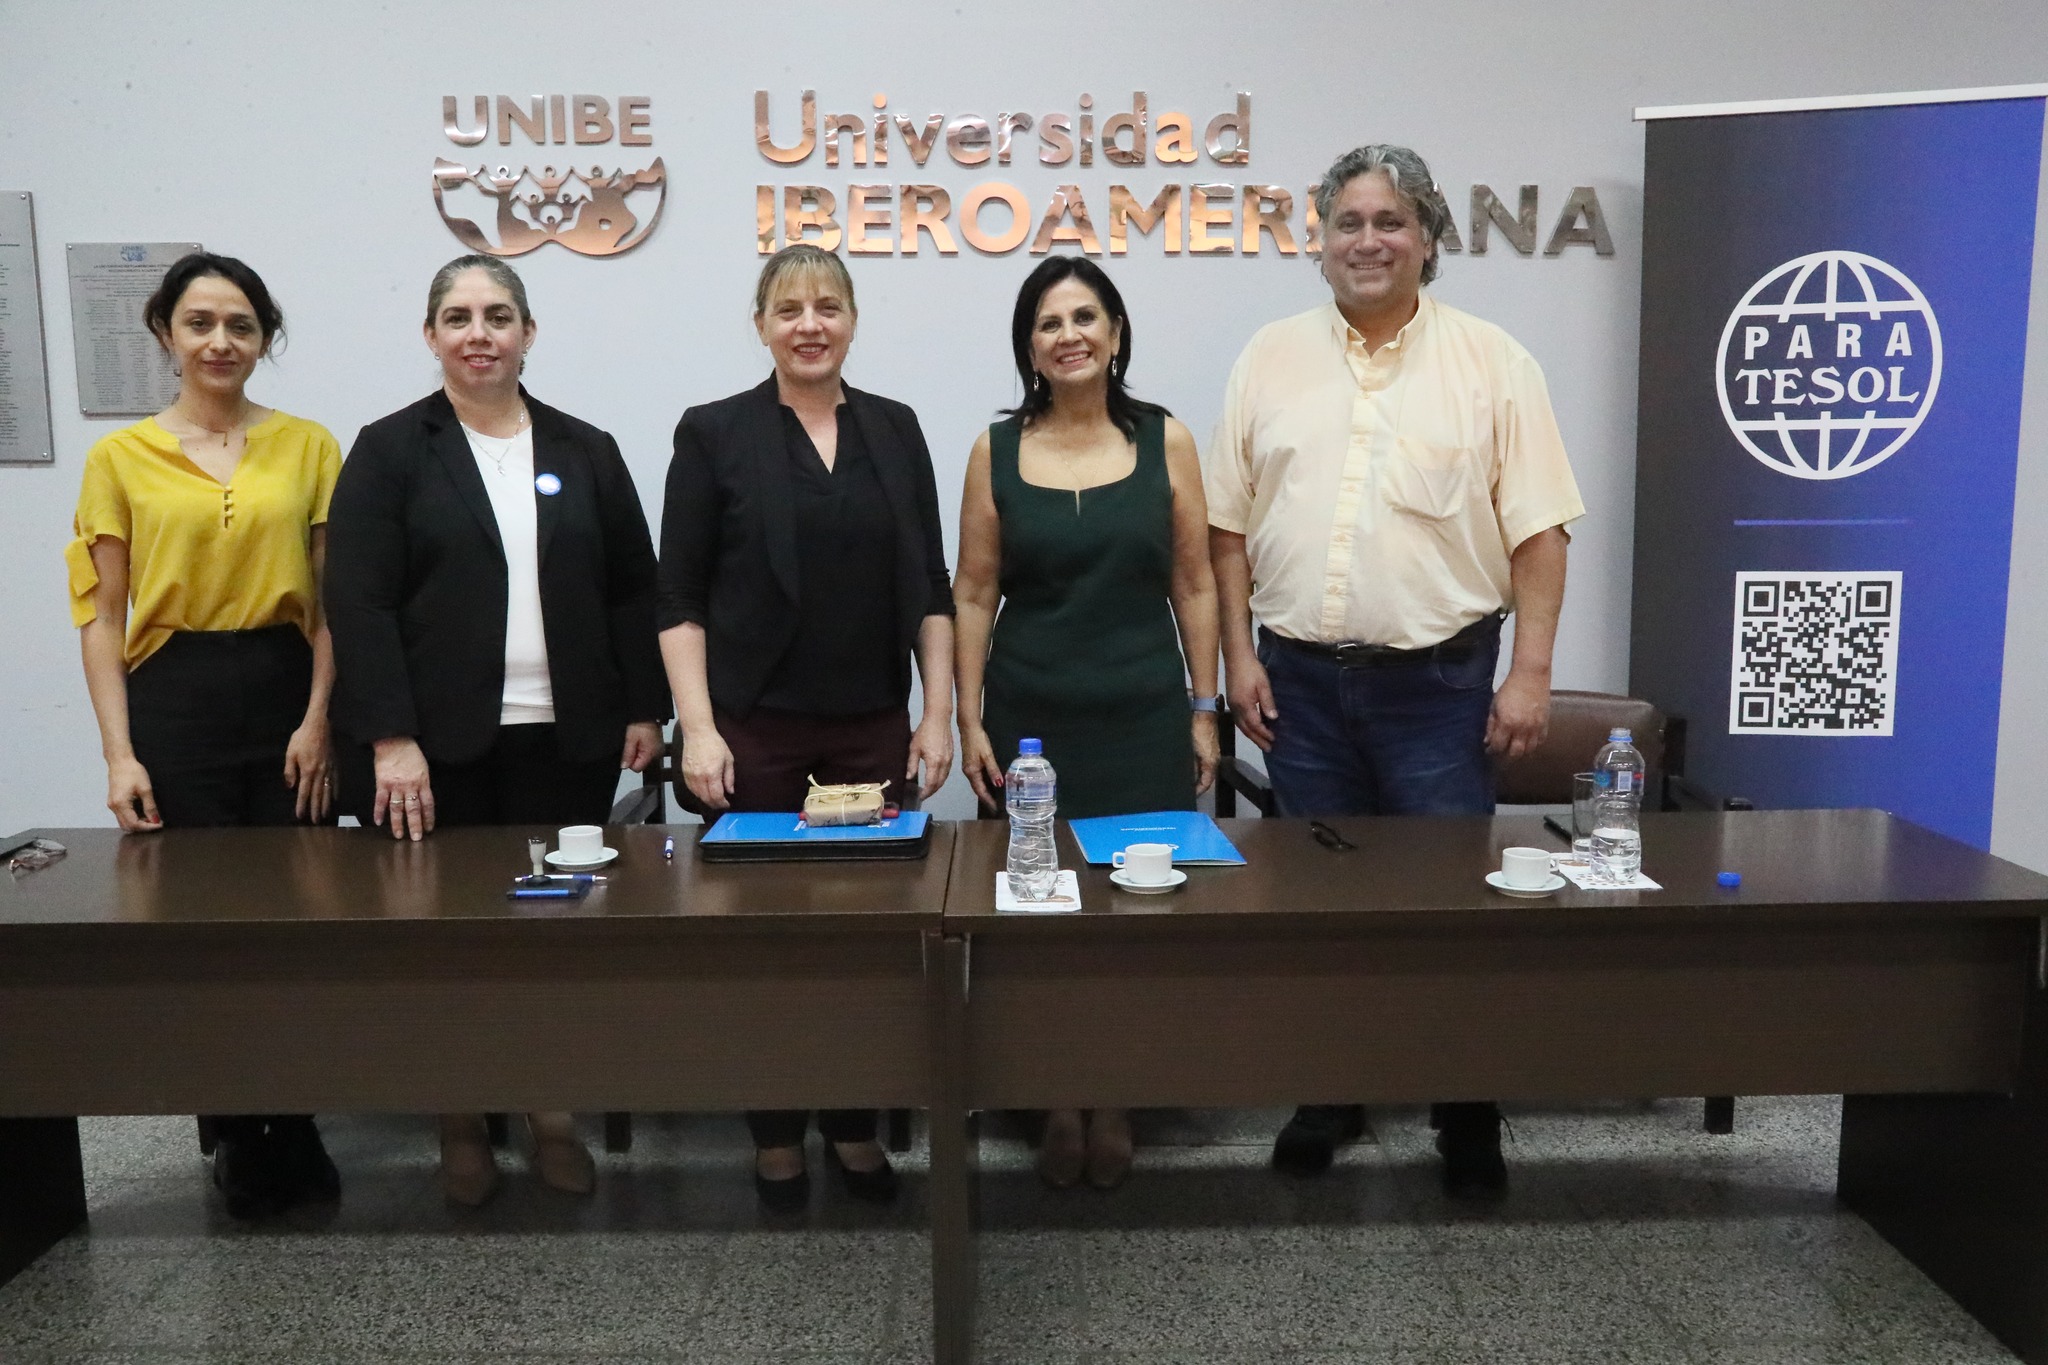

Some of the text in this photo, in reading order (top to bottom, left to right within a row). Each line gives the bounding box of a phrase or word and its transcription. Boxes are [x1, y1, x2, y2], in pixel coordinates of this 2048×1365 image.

[442, 95, 654, 145] UNIBE
[755, 90, 1251, 165] Universidad
[756, 184, 1614, 254] IBEROAMERINA
[1744, 322, 1912, 360] PARA
[1735, 366, 1919, 405] TESOL
